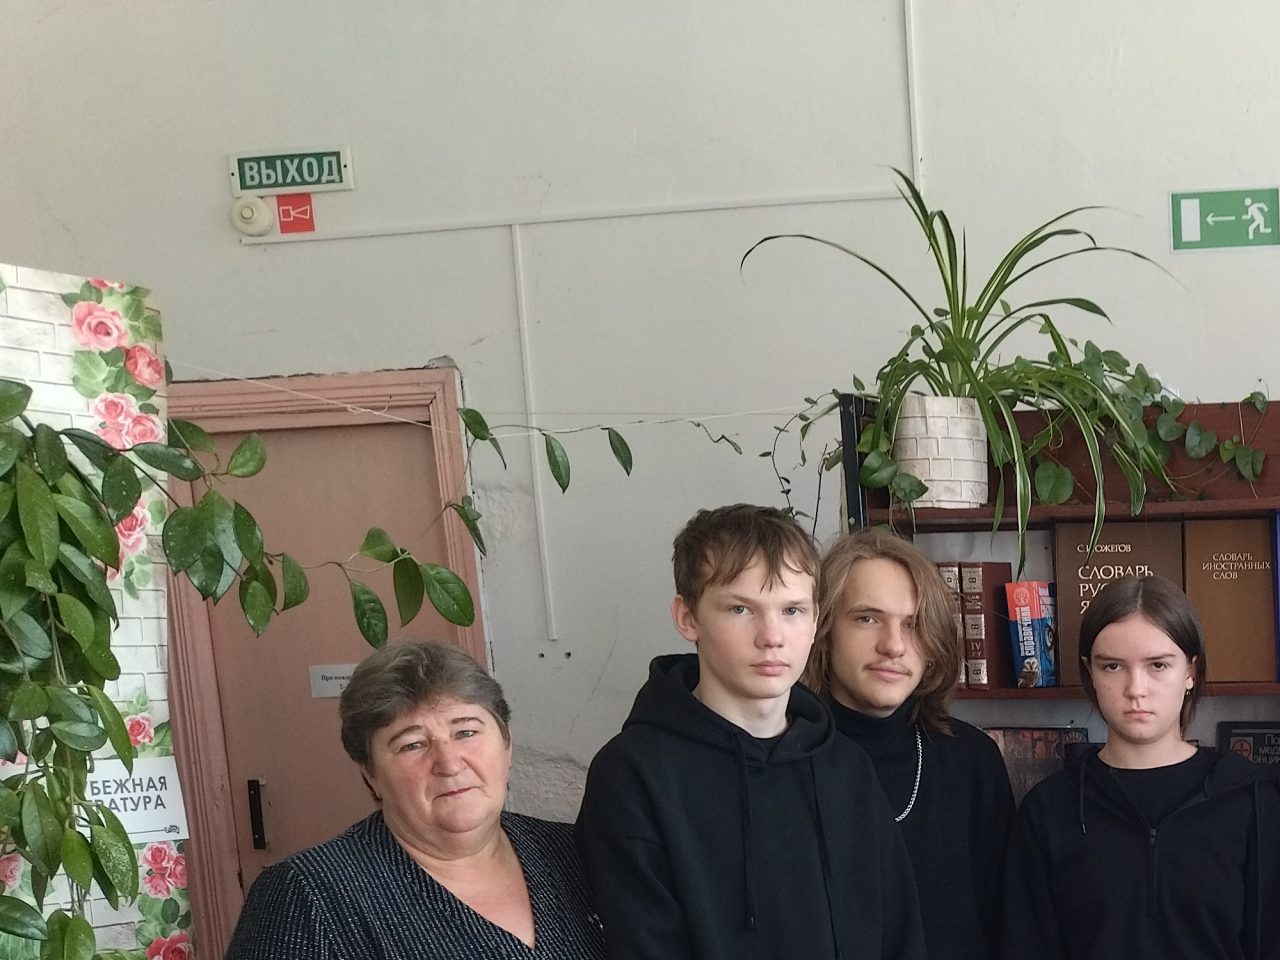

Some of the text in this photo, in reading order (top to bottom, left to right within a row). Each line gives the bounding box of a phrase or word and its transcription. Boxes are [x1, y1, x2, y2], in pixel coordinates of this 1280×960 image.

[243, 156, 340, 186] ВЫХОД
[1213, 553, 1253, 561] СЛОВАРЬ
[1202, 562, 1271, 570] ИНОСТРАННЫХ
[1078, 565, 1153, 579] СЛОВАРЬ
[1213, 572, 1238, 580] СЛОВ
